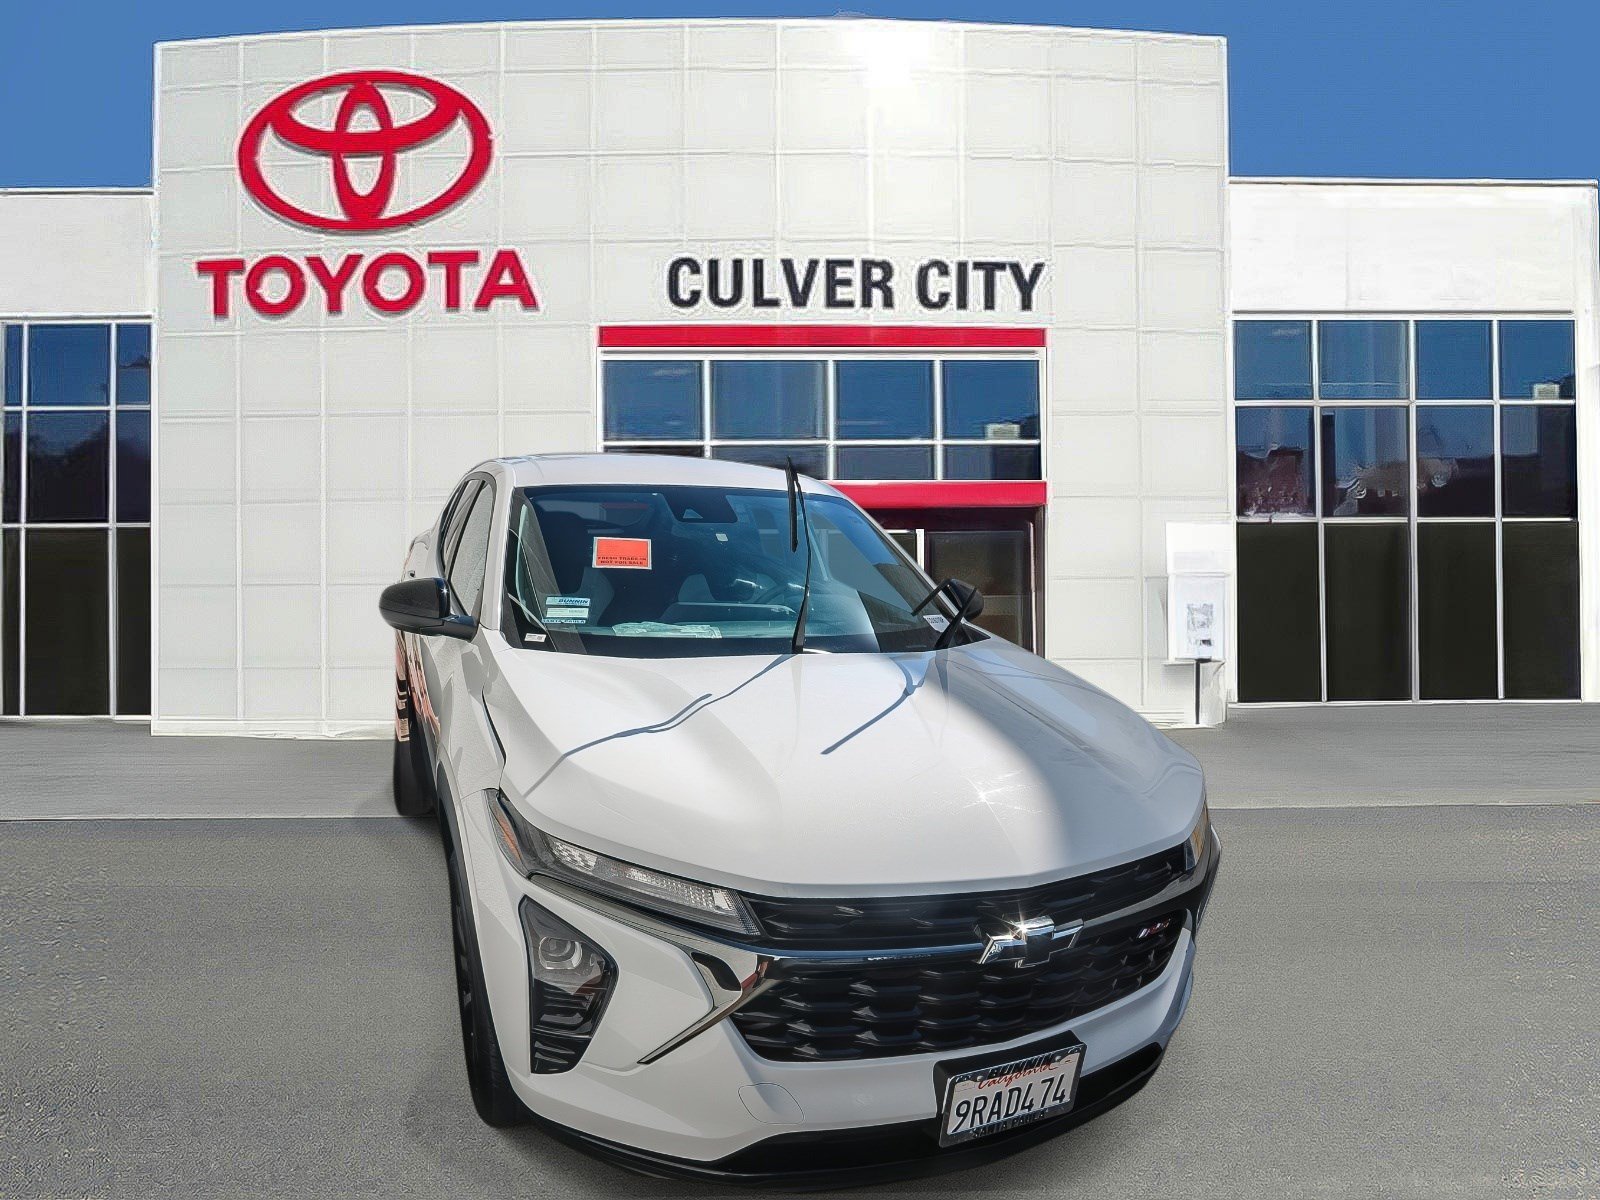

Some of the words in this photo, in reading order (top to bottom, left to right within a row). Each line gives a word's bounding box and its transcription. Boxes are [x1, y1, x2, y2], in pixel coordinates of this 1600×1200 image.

[195, 250, 538, 318] TOYOTA
[667, 257, 895, 309] CULVER
[915, 258, 1045, 311] CITY
[951, 1073, 1066, 1133] 9RAD474
